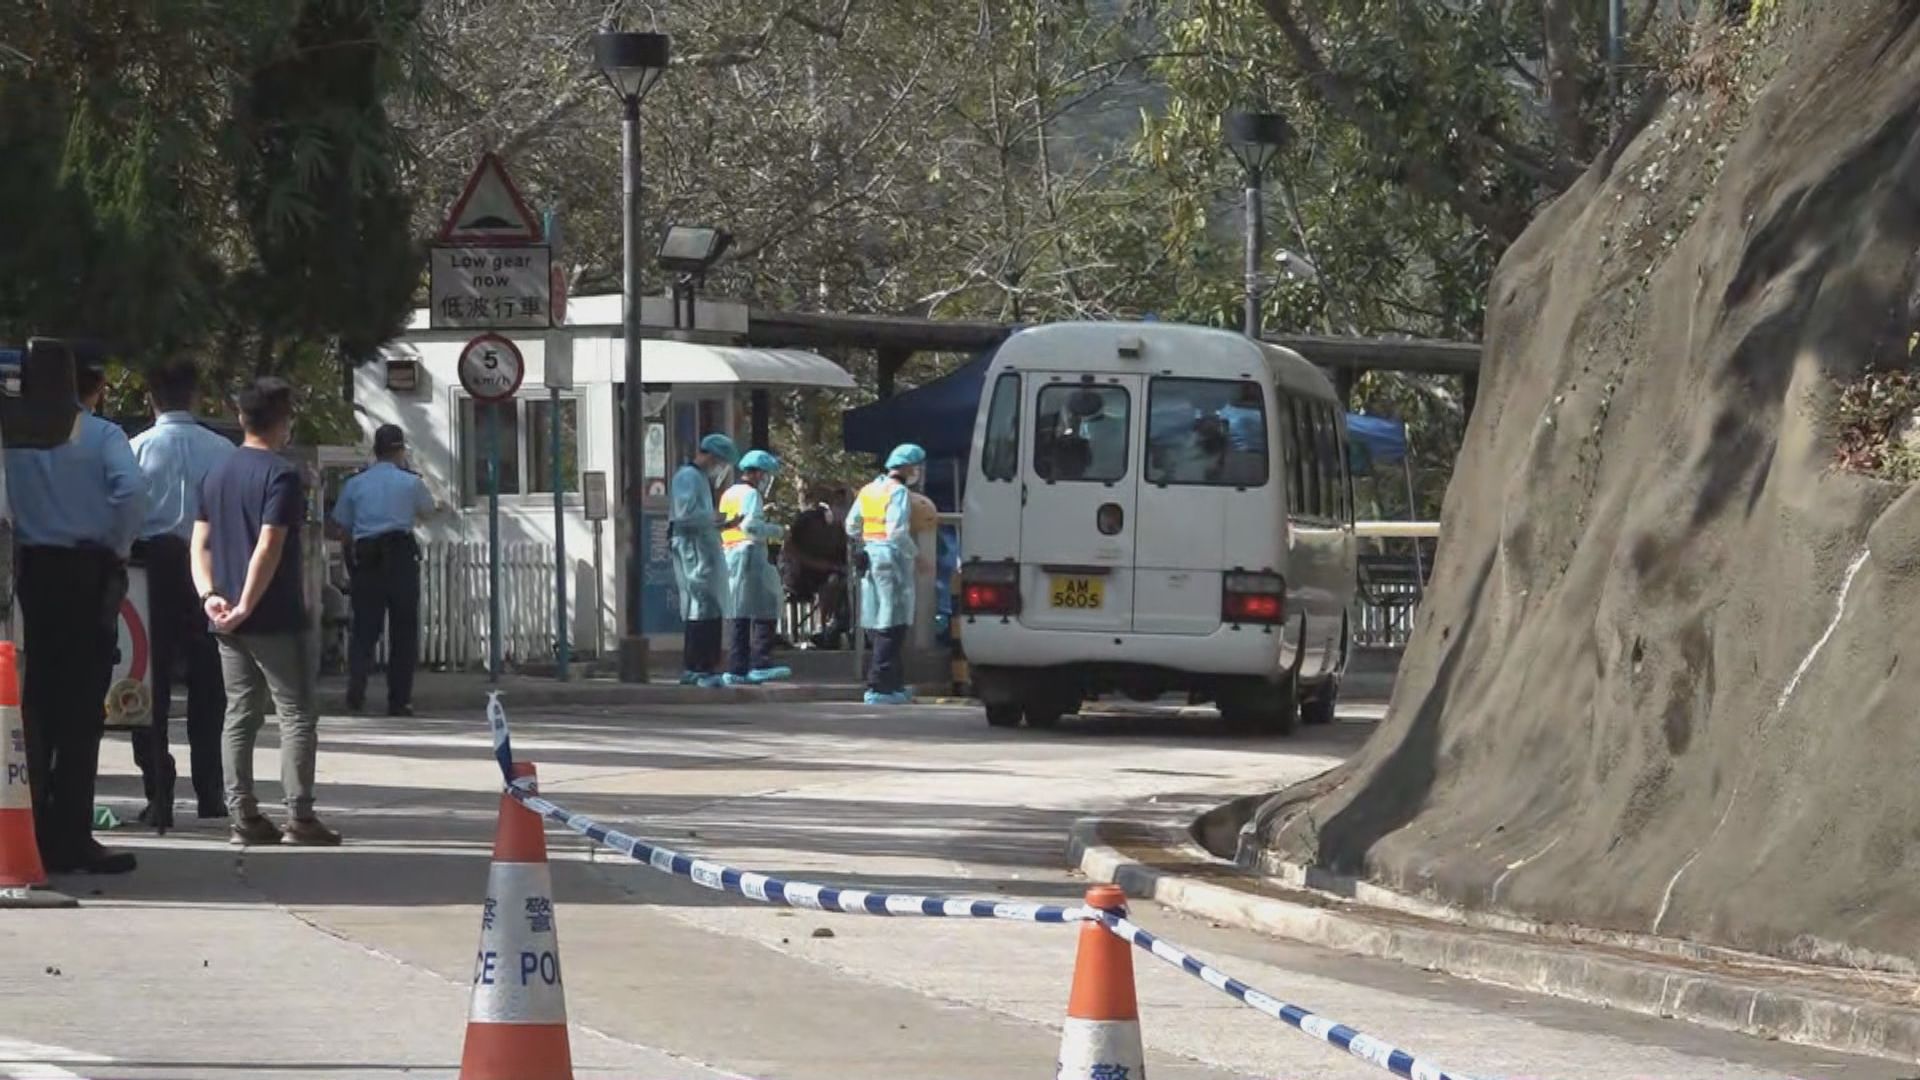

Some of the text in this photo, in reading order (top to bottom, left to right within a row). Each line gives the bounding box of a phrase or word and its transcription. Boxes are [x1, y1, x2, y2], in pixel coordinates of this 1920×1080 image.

[452, 255, 531, 271] Low gear
[473, 276, 510, 287] now
[442, 295, 543, 319] 低波行車
[484, 350, 498, 369] 5
[1066, 579, 1089, 593] AM
[1053, 592, 1099, 608] 5605
